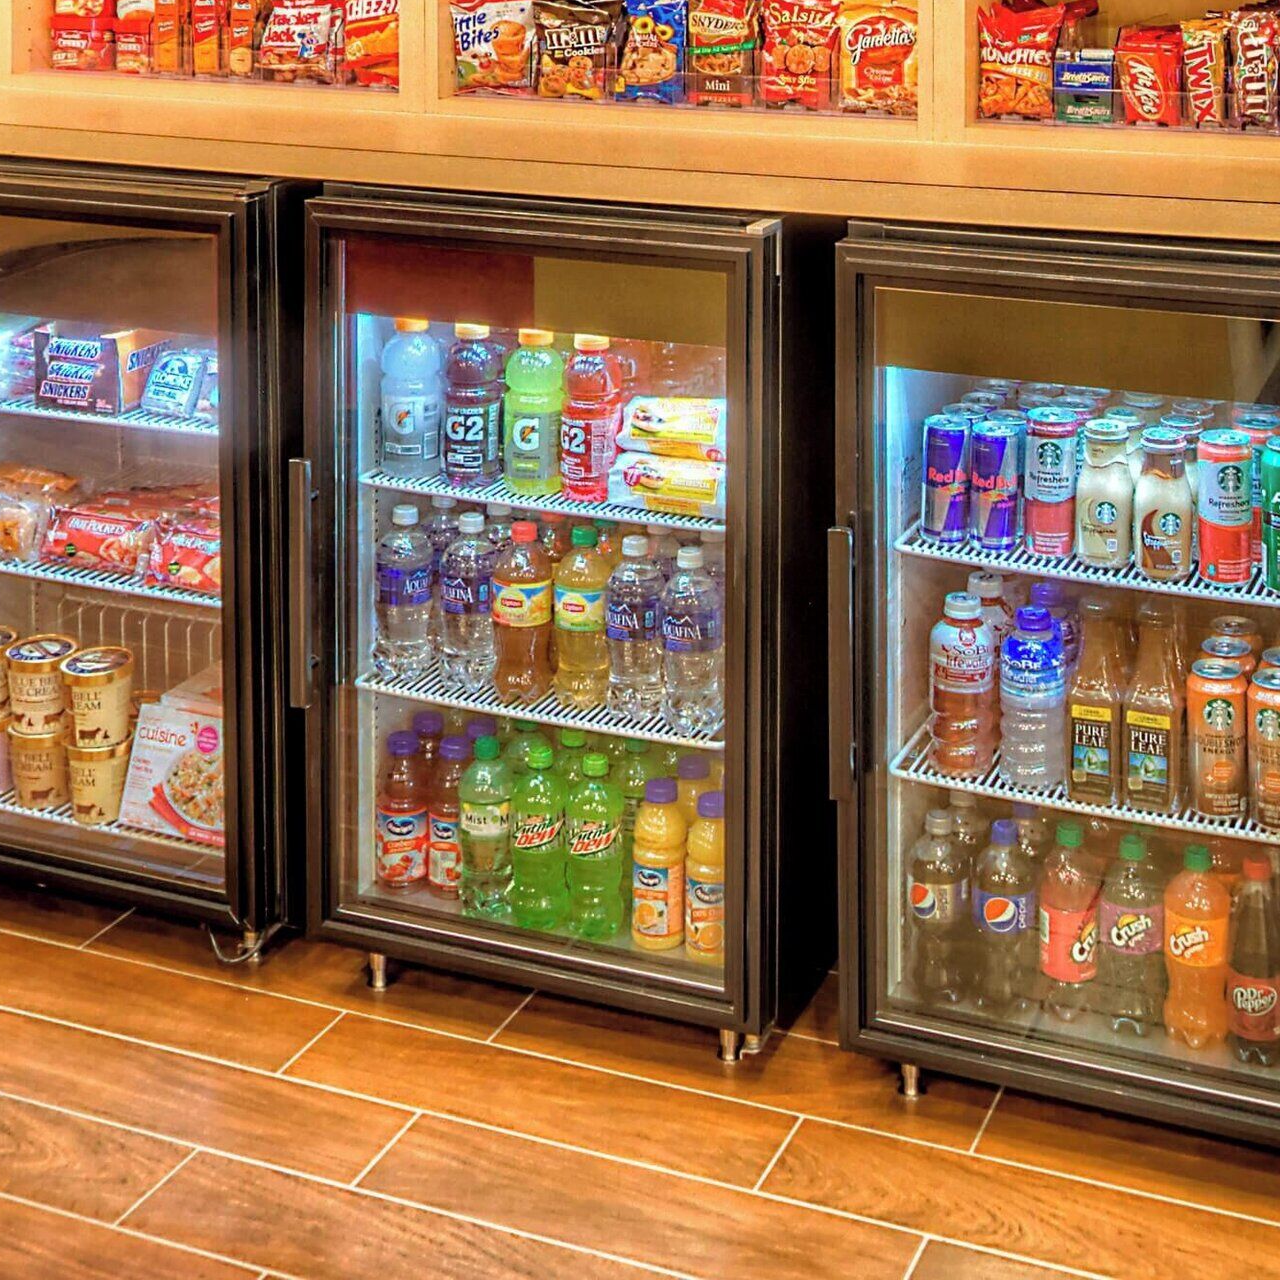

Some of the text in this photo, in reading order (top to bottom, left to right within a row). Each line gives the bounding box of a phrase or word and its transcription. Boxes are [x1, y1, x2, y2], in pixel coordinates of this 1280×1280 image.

[273, 11, 321, 25] racker
[454, 12, 487, 33] ittle
[265, 27, 296, 42] Jack
[460, 26, 499, 51] Bites
[564, 48, 605, 57] Cookies
[981, 47, 1052, 66] MUNCHIES
[705, 80, 731, 91] Mini
[1128, 59, 1160, 116] Kit Kat
[1184, 42, 1217, 122] TWIX
[41, 382, 89, 399] SNICKERS
[447, 415, 484, 441] G2
[513, 418, 540, 451] G
[928, 467, 951, 483] Red
[973, 472, 994, 487] Red
[442, 585, 473, 604] UAFINA
[606, 611, 639, 630] QUAFINA
[27, 684, 60, 698] CREA
[73, 701, 101, 711] EAM
[140, 726, 186, 747] cuisine
[1075, 724, 1108, 737] PURE
[1131, 731, 1167, 745] PURE
[1074, 734, 1106, 747] LEAF
[1130, 743, 1164, 756] LEAF
[1203, 747, 1236, 755] ENERGY
[21, 760, 53, 770] REAM
[466, 813, 487, 825] Mist
[1111, 915, 1152, 947] Crush
[1072, 930, 1097, 962] Cru
[1170, 927, 1209, 956] Crush
[1233, 988, 1275, 1012] Pepper
[1248, 988, 1263, 999] Dr
